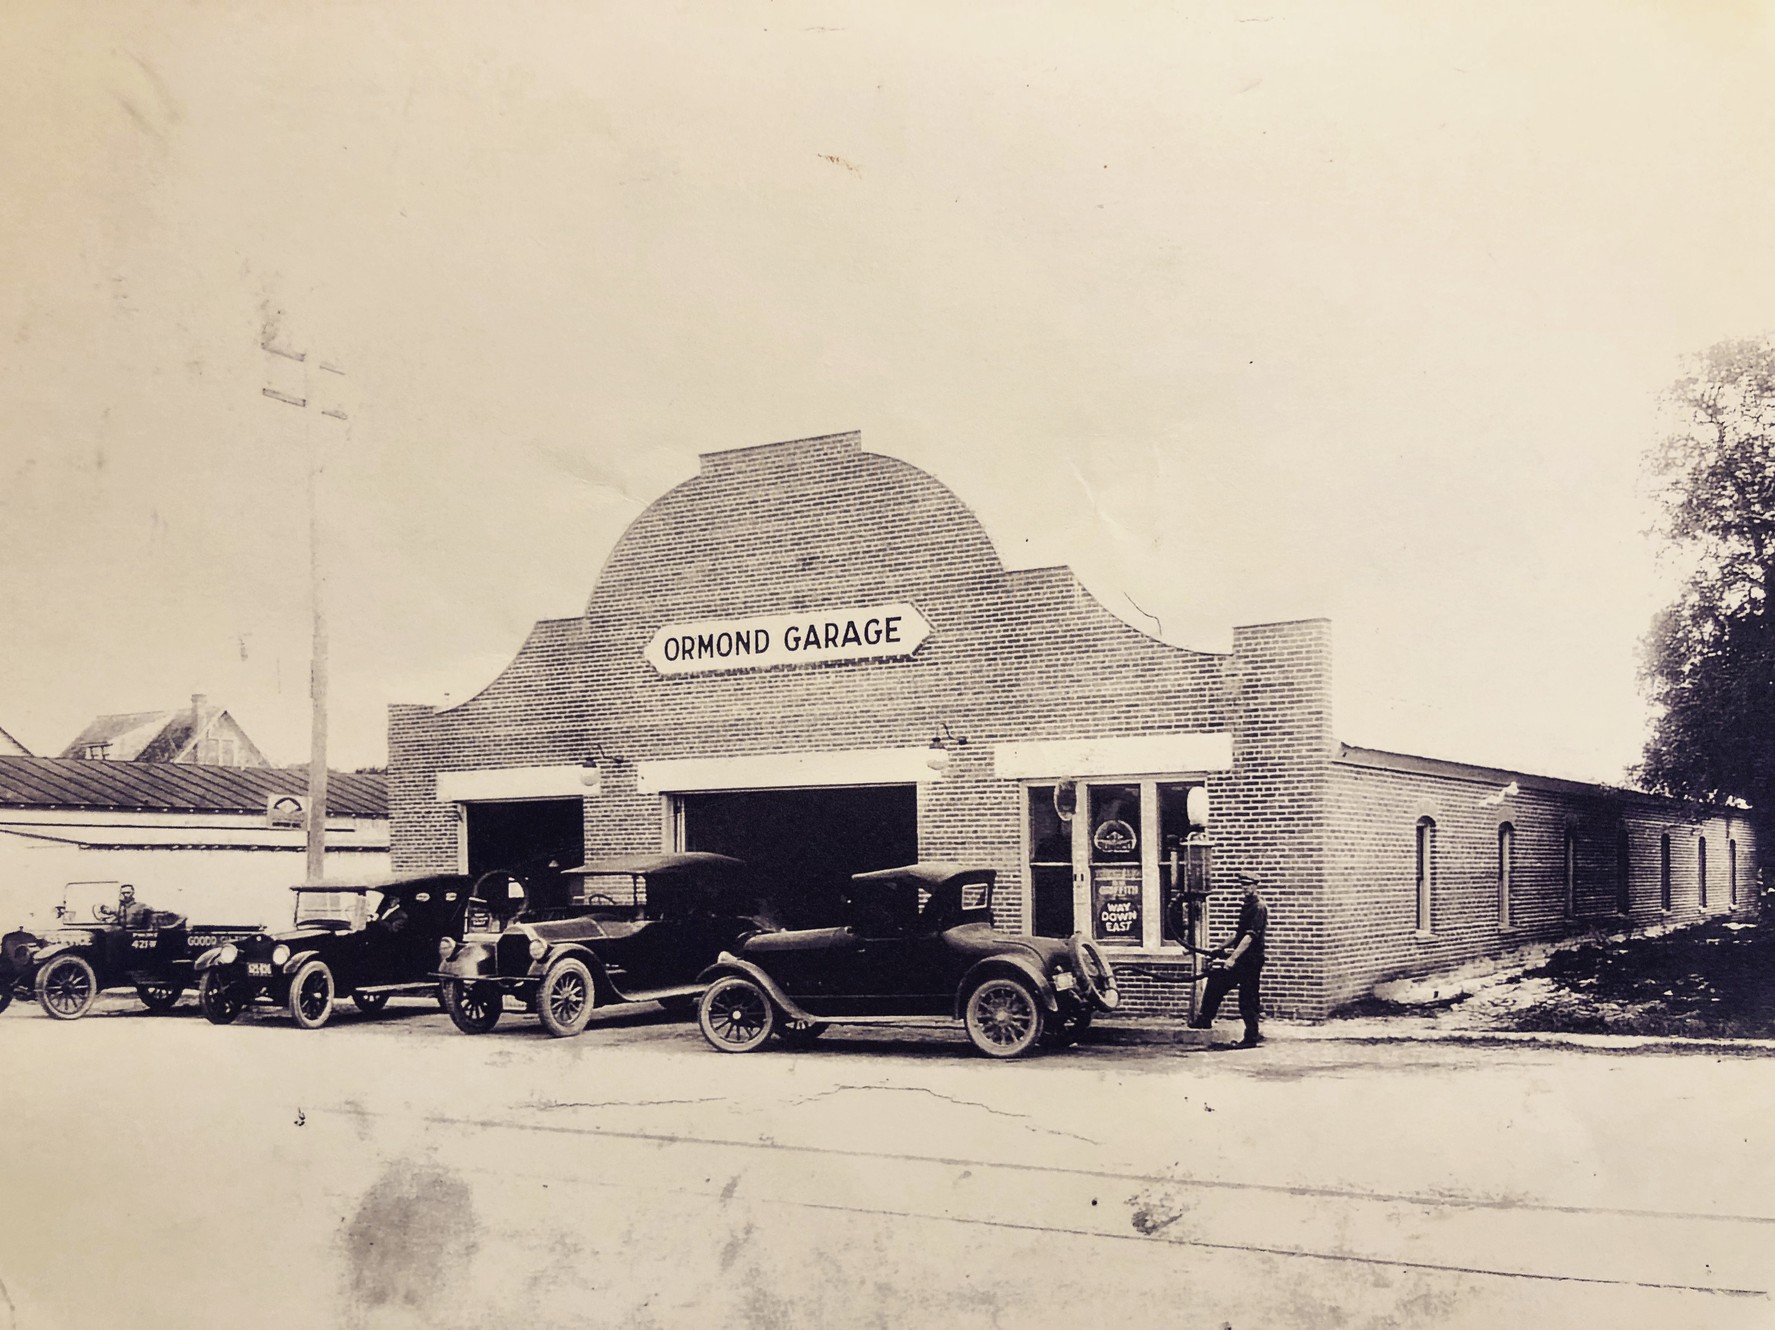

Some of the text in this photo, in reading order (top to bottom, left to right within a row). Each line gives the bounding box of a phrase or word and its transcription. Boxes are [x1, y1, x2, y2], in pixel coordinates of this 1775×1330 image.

[664, 616, 902, 661] ORMOND GARAGE
[1107, 903, 1131, 912] WAY
[1101, 911, 1137, 921] DOWN
[1105, 921, 1132, 932] EAST
